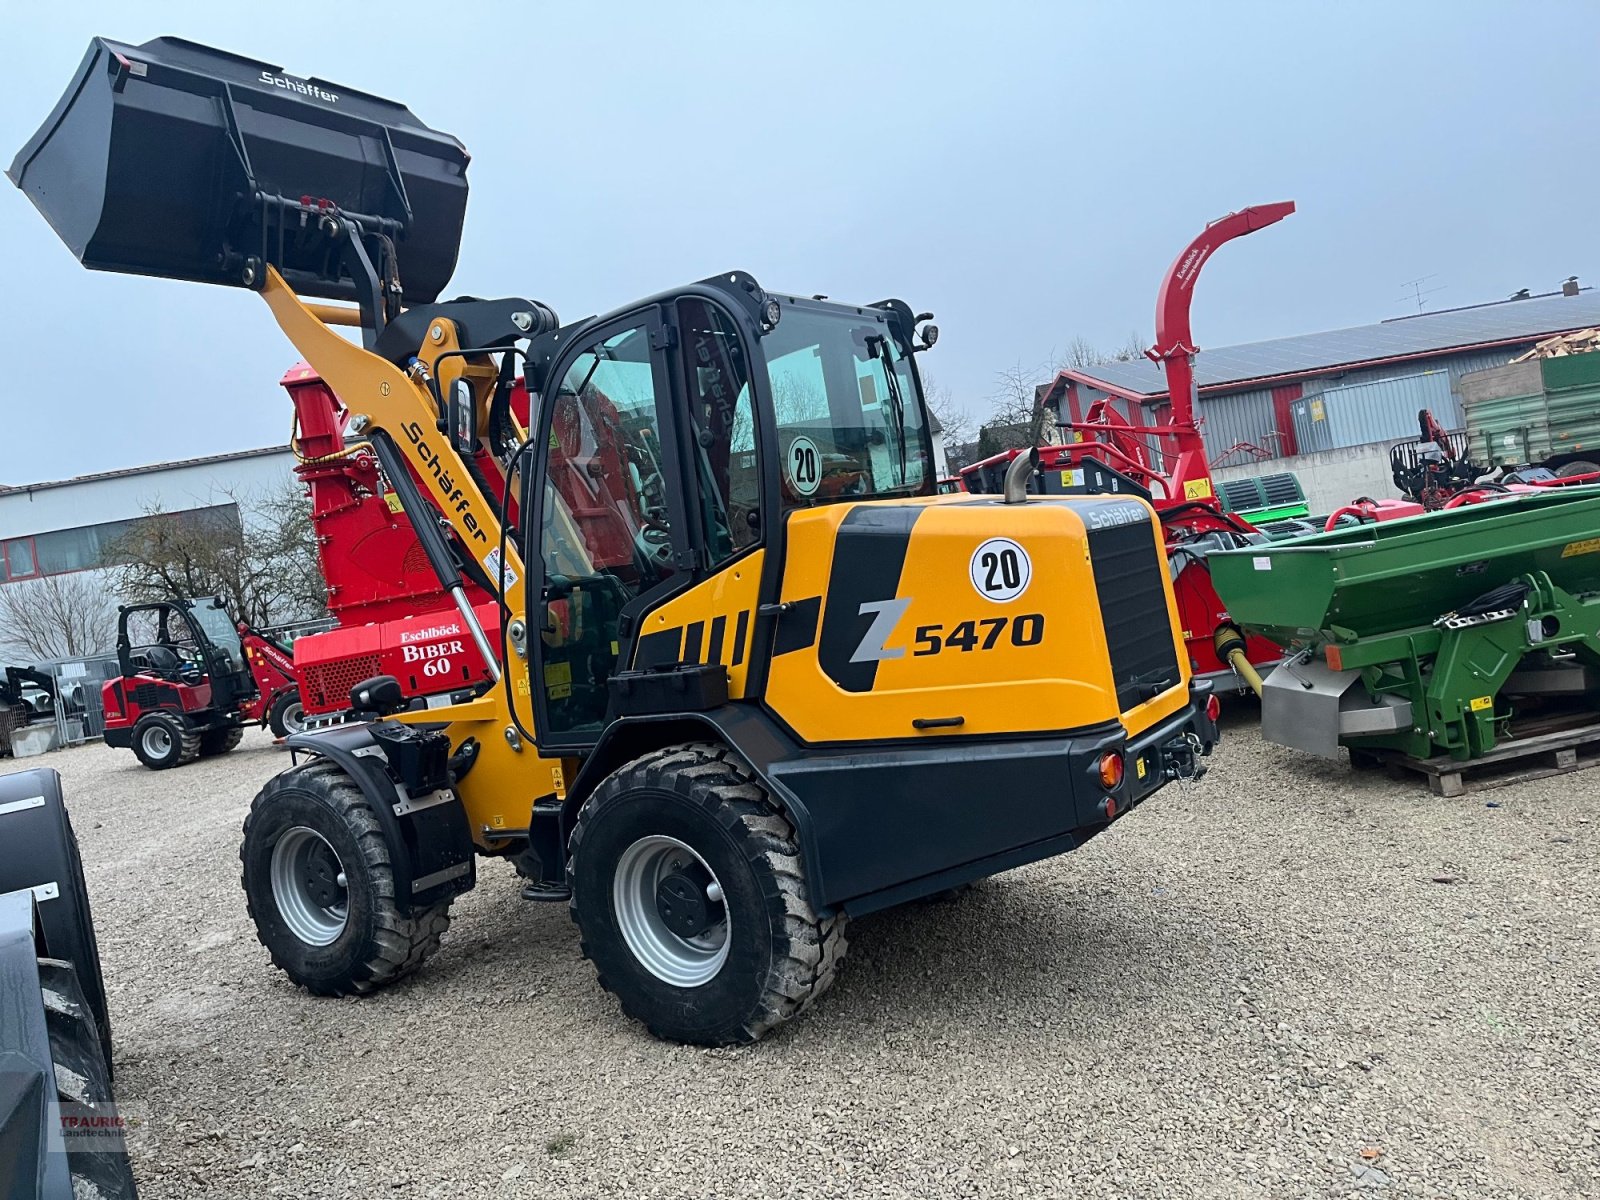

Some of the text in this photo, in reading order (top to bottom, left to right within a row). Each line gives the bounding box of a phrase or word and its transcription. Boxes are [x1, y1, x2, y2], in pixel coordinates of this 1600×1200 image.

[258, 71, 339, 103] Schäffer
[794, 447, 816, 483] 20
[400, 421, 487, 543] Schäffer
[1088, 506, 1143, 529] Schäffer
[981, 548, 1021, 592] 20
[400, 623, 461, 643] Eschlböck
[848, 597, 1045, 663] Z 5470
[261, 646, 294, 670] Schäffer
[401, 640, 465, 663] BIBER
[423, 657, 451, 677] 60
